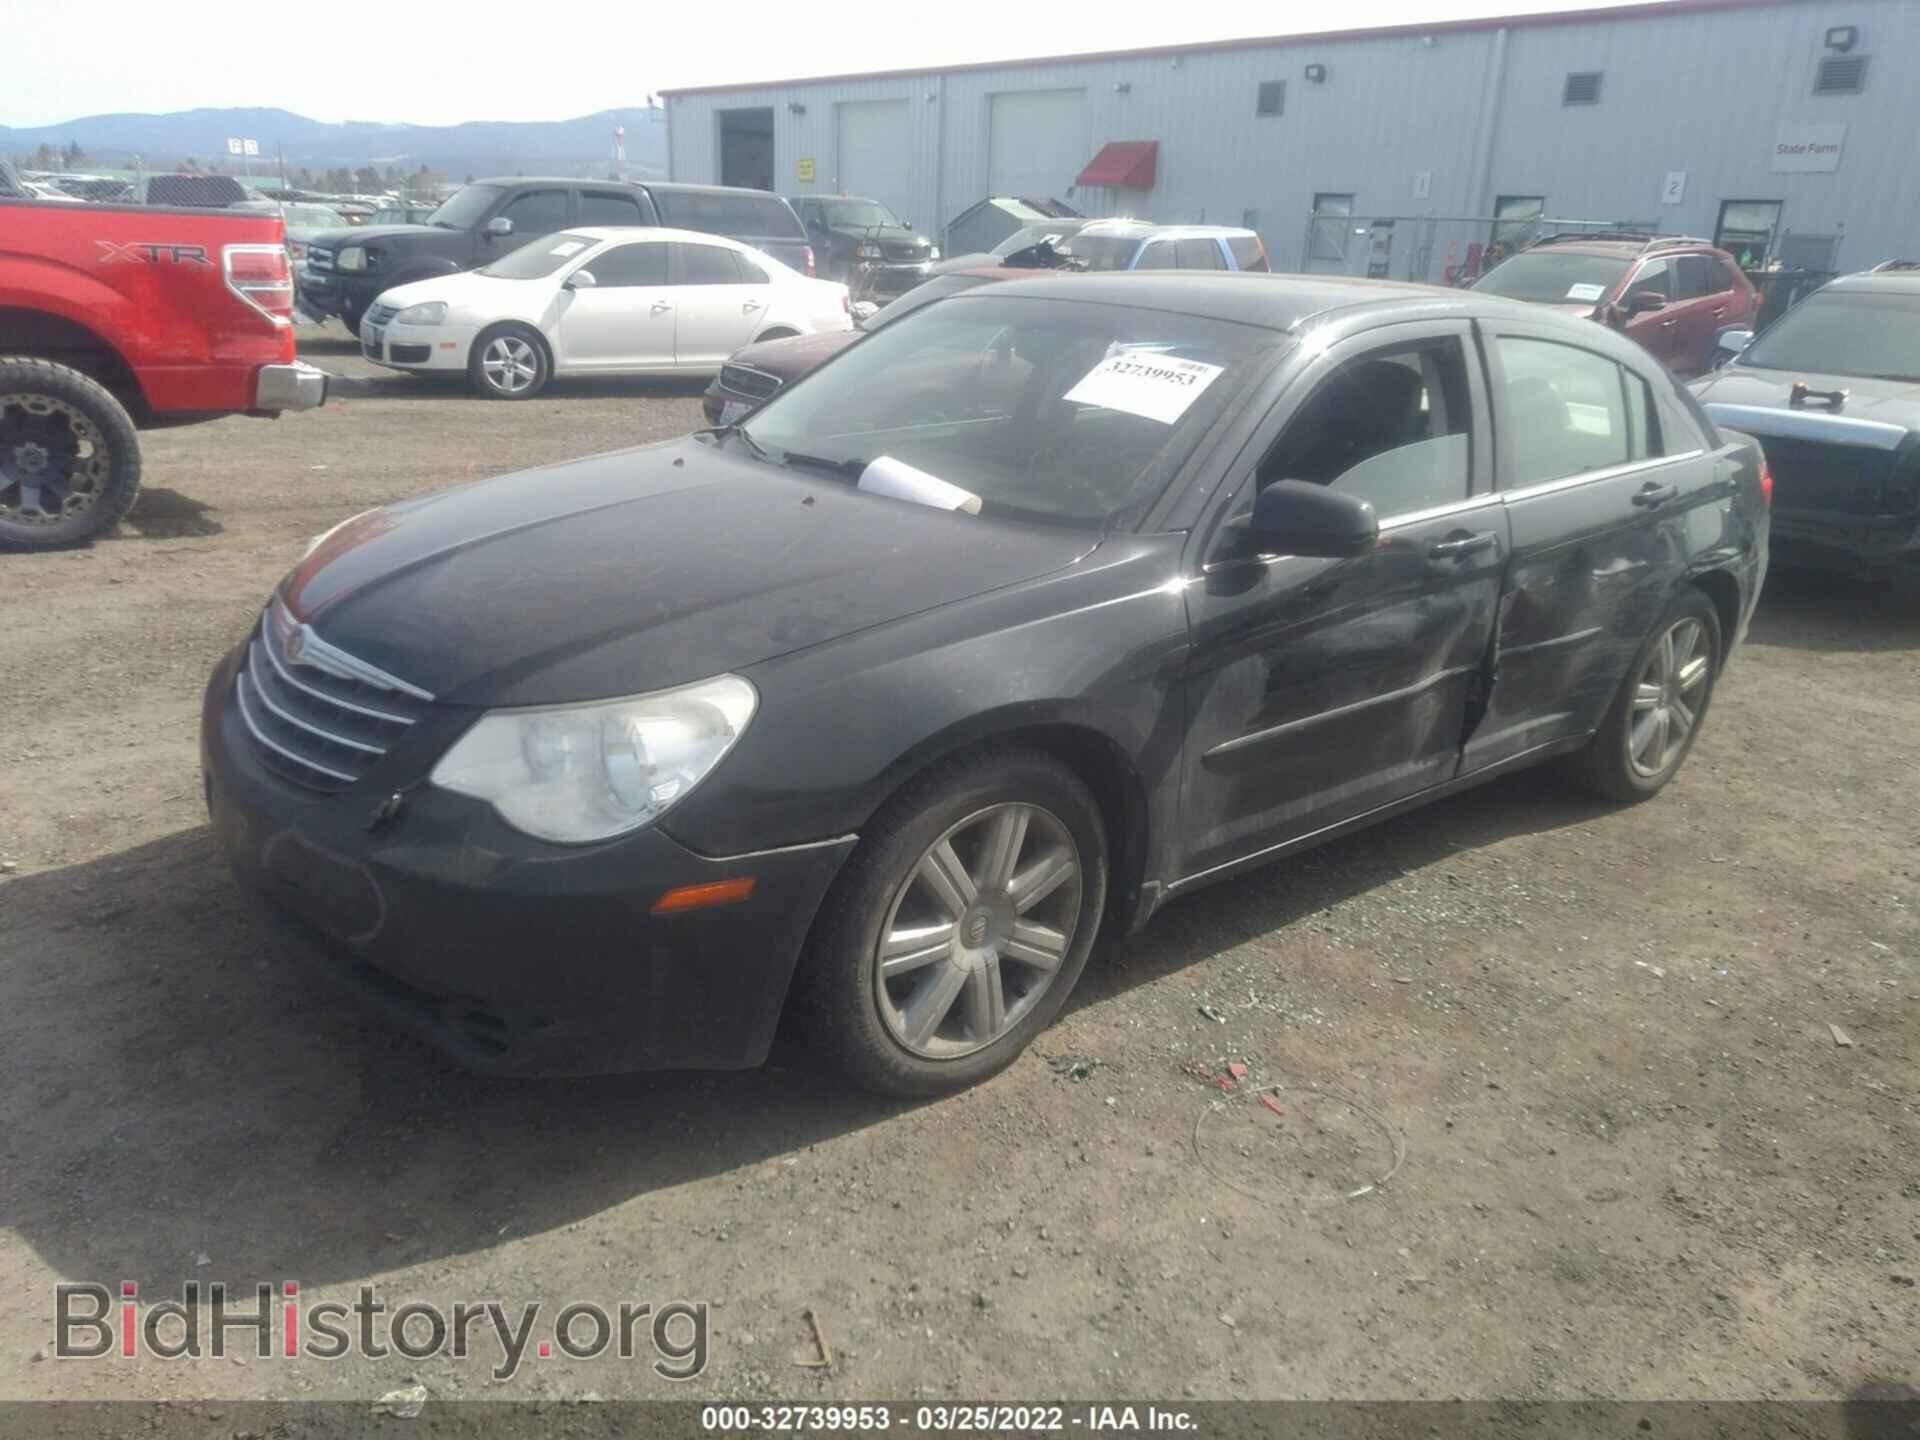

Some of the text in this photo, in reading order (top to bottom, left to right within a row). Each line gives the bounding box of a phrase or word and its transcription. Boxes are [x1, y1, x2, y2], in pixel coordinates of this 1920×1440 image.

[1776, 142, 1839, 154] State Farm
[1670, 180, 1680, 194] 2
[95, 240, 215, 265] XTR
[1105, 361, 1197, 386] 32739953
